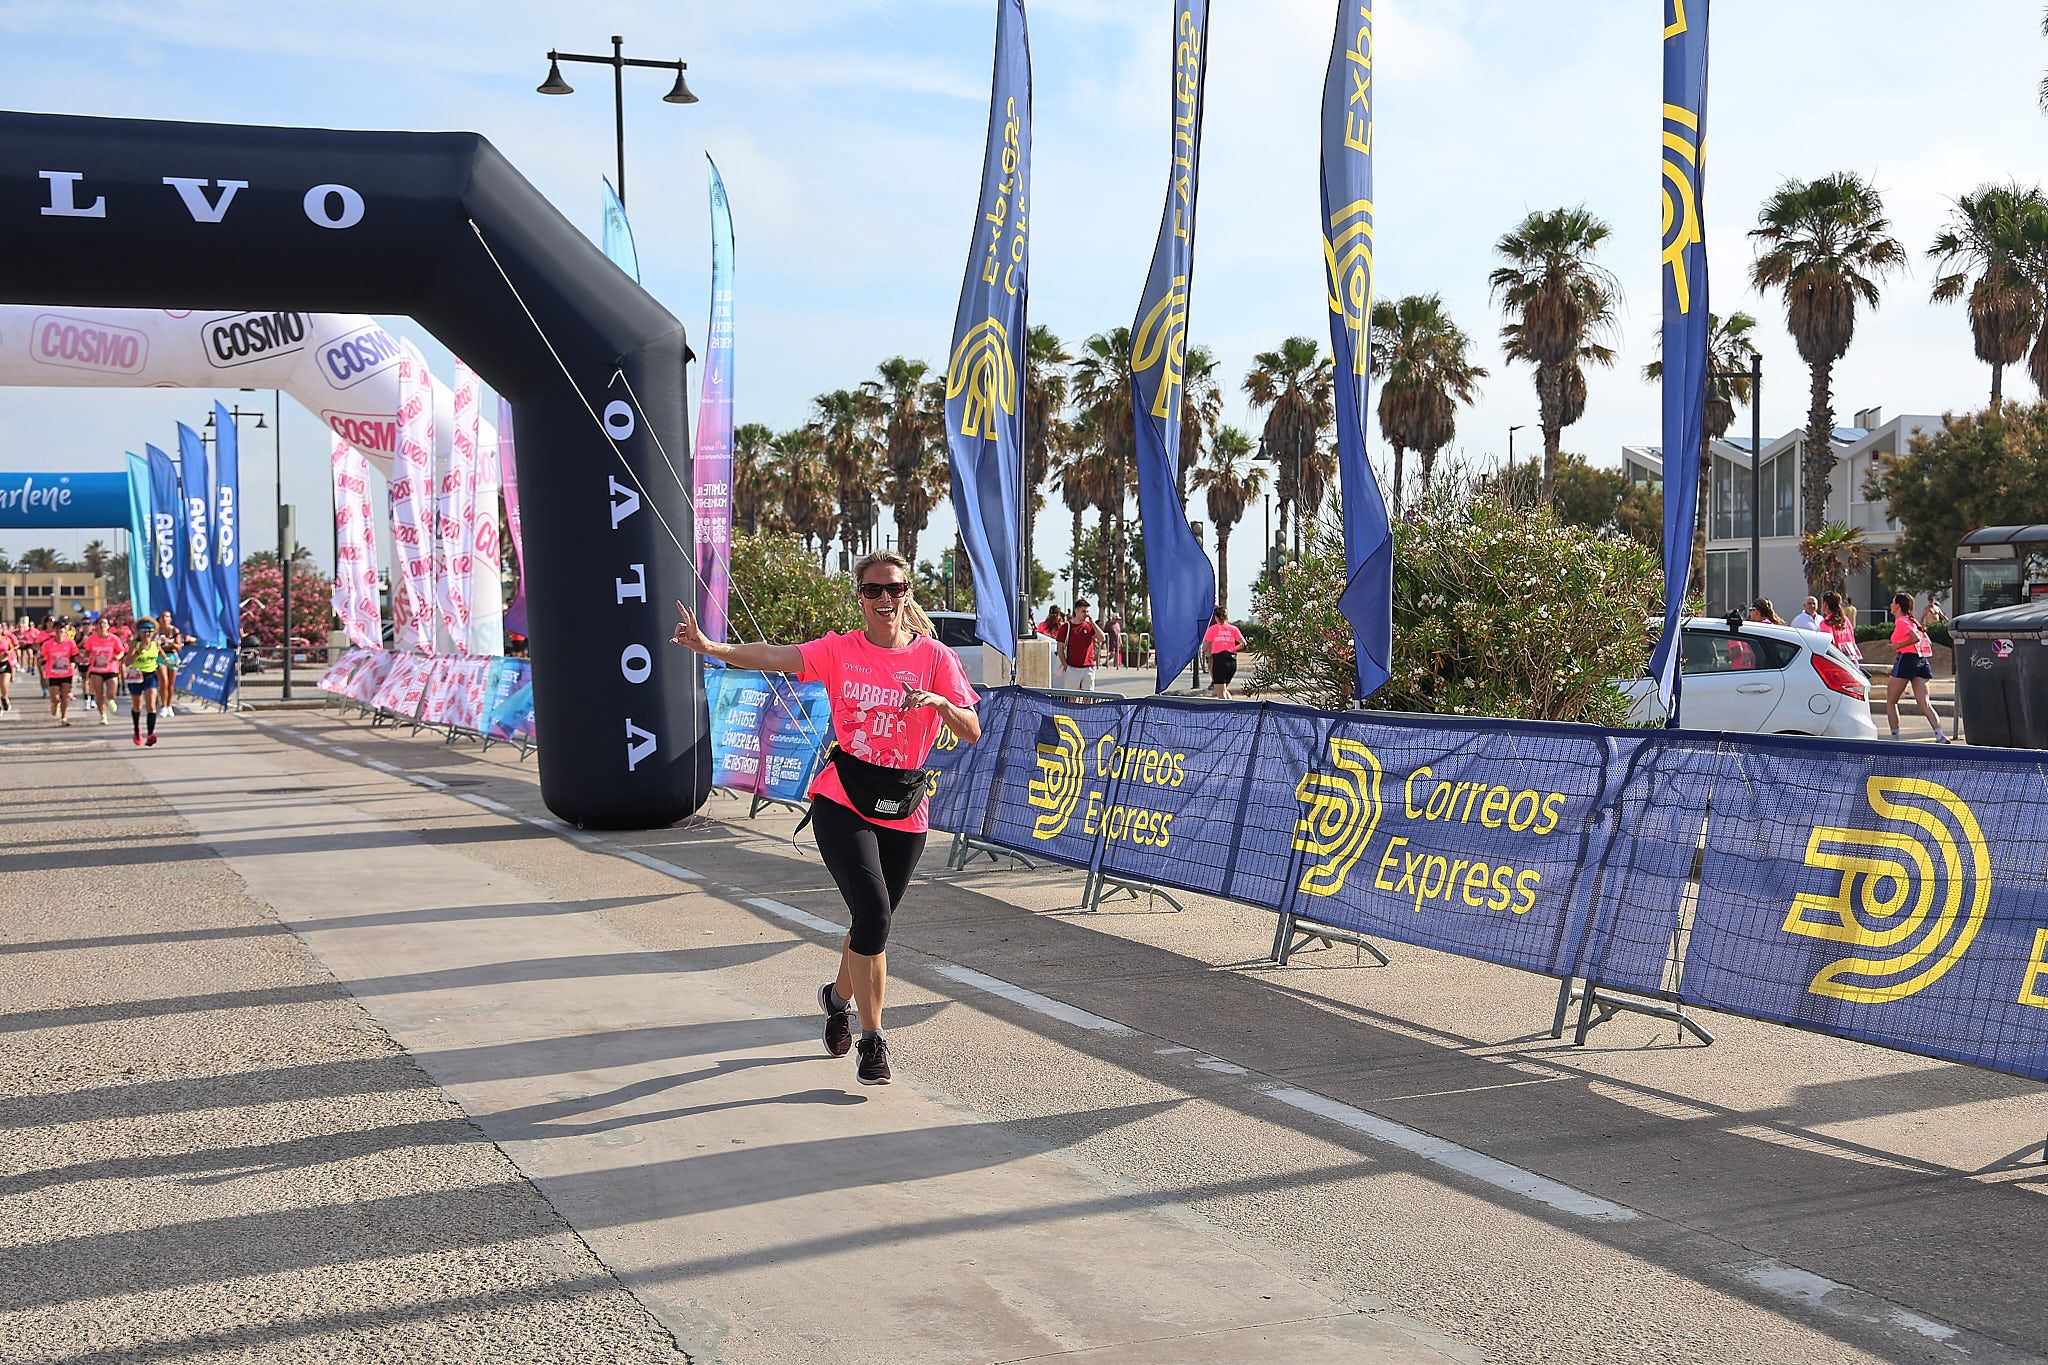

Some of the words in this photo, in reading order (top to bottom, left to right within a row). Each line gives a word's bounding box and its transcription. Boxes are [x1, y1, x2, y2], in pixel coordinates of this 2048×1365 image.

[41, 321, 139, 369] COSMO
[212, 311, 303, 361] COSMO
[330, 415, 396, 452] COSM
[603, 400, 657, 772] VOLVO
[1096, 734, 1186, 789] Correos
[1084, 791, 1173, 848] Express
[1403, 765, 1567, 836] Correos
[1376, 836, 1542, 916] Express
